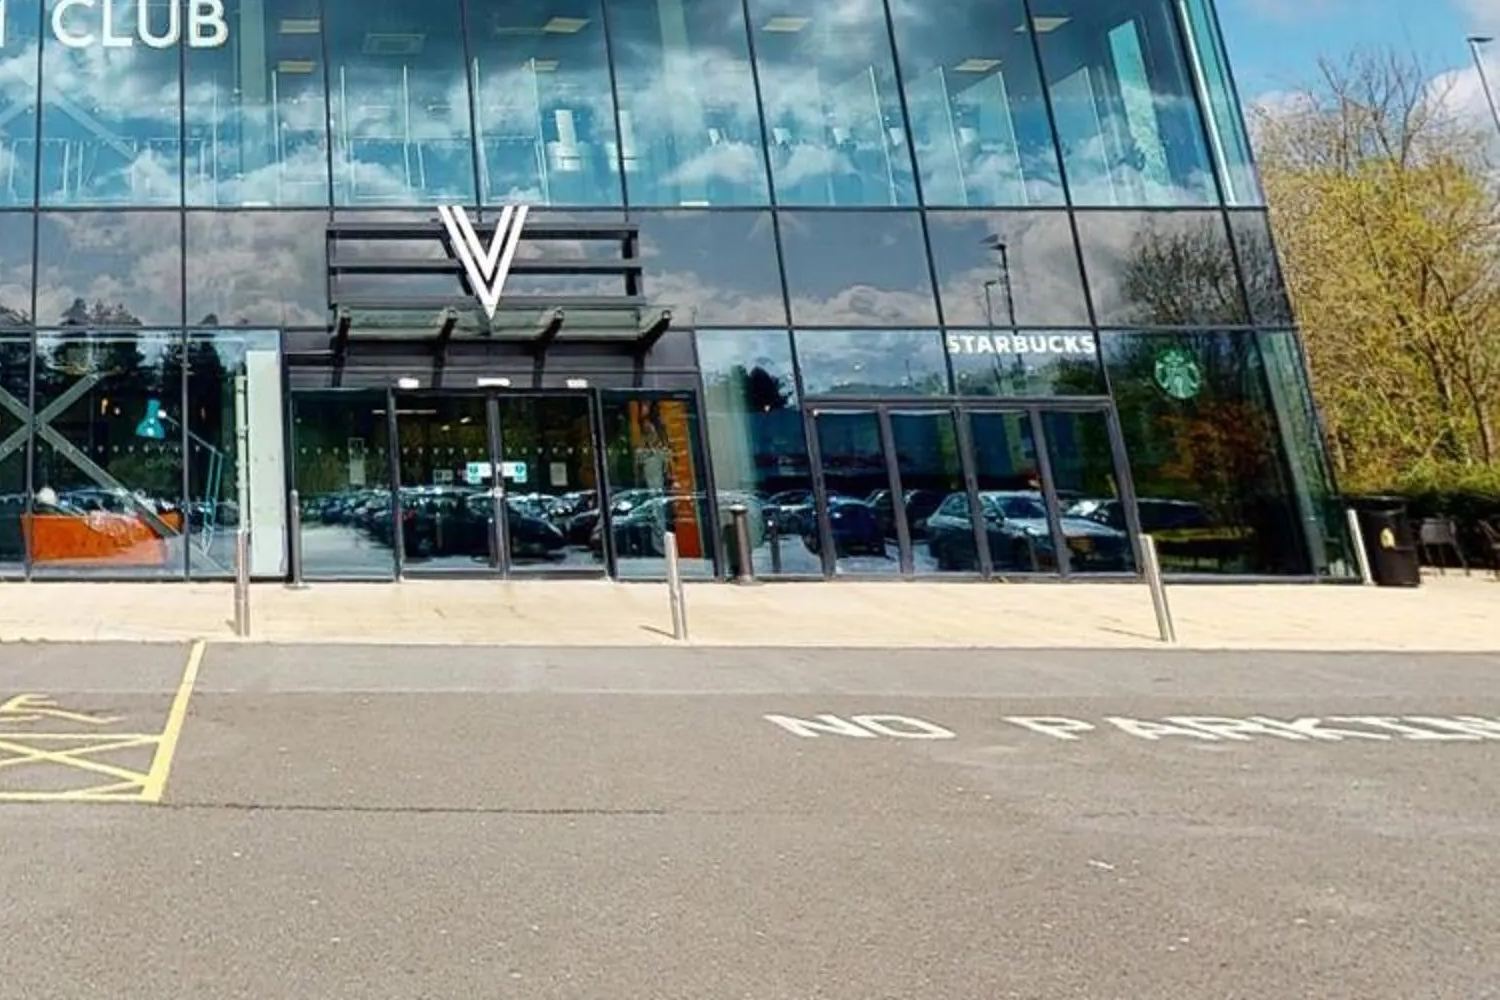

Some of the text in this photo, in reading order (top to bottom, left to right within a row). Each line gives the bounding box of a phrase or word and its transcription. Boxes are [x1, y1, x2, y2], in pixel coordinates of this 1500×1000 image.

[439, 205, 529, 320] V
[947, 334, 1096, 354] STARBUCKS
[763, 714, 1500, 742] NO PARKIN
